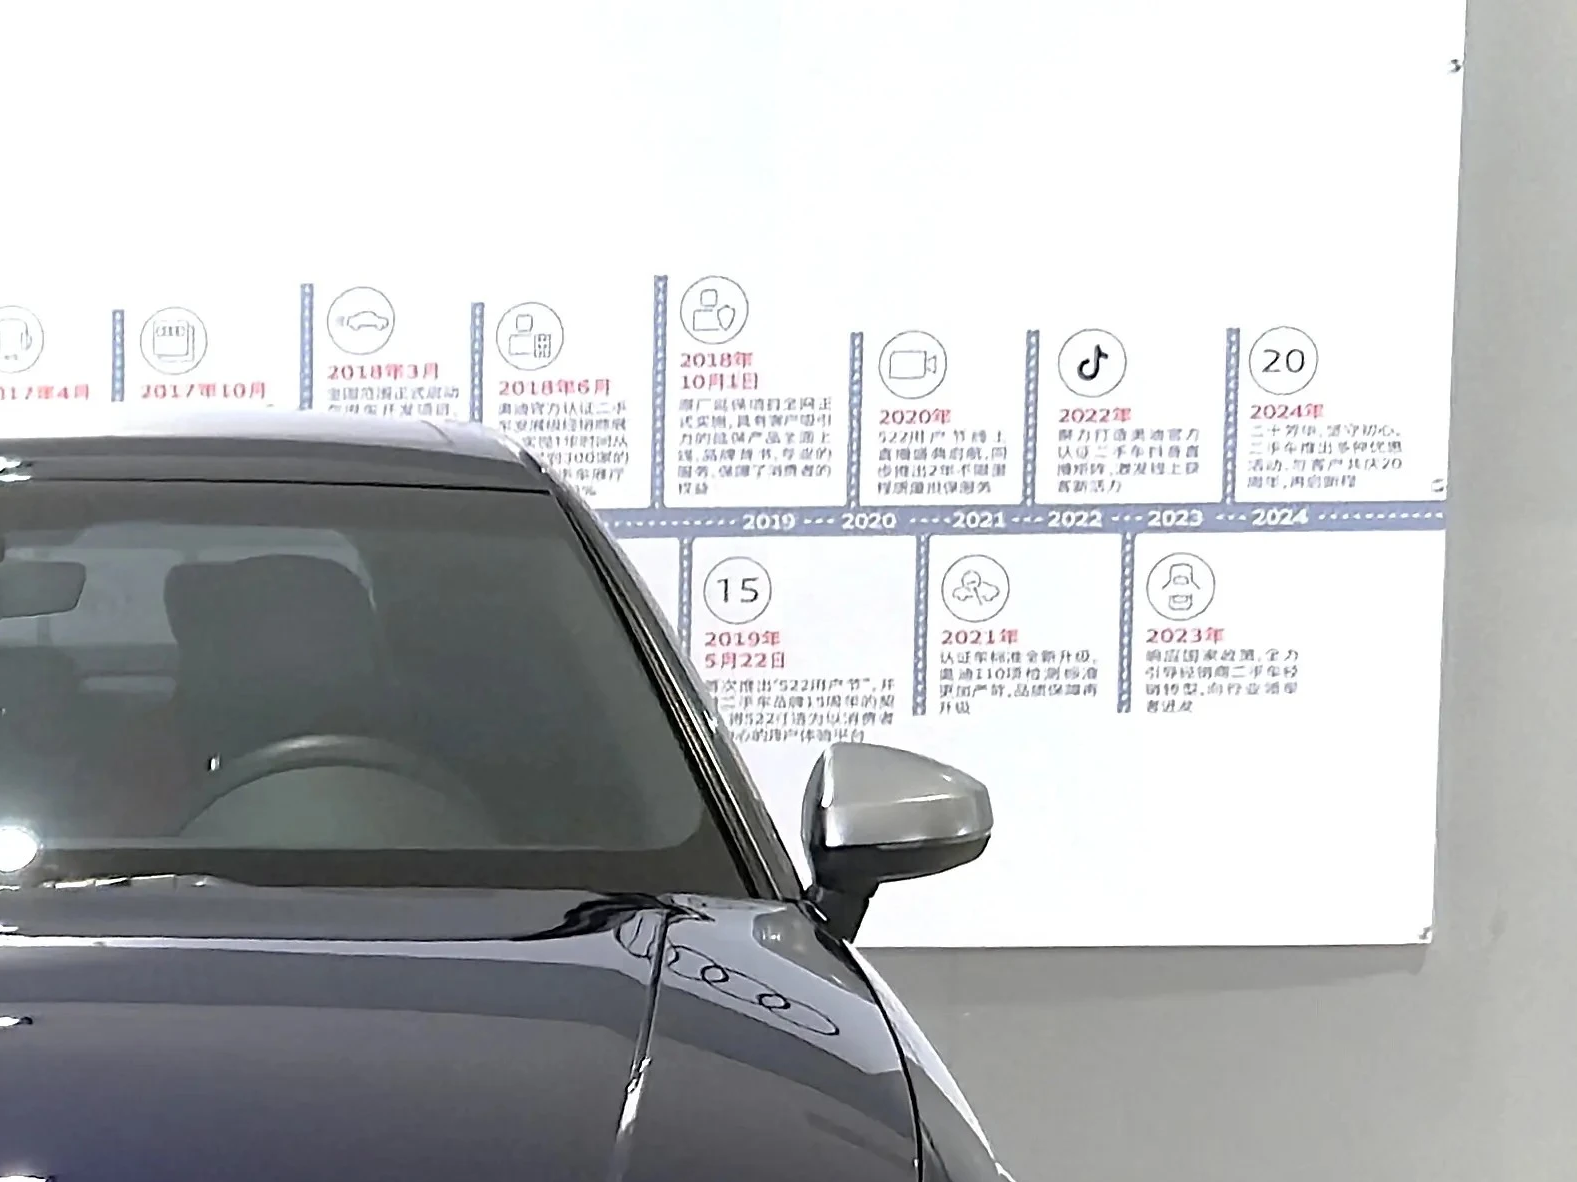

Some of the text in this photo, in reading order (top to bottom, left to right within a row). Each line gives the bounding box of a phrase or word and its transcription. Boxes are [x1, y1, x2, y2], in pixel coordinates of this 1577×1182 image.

[680, 351, 753, 368] 2018年
[1261, 348, 1307, 374] 20
[328, 363, 438, 380] 2018年3月
[499, 379, 610, 396] 2018年6月
[681, 372, 758, 391] 10月1日
[142, 382, 265, 399] 2017年10月
[879, 408, 951, 425] 2020年
[1059, 407, 1131, 423] 2022年
[1250, 403, 1323, 419] 2024年
[744, 514, 795, 529] 2019
[843, 513, 896, 528] 2020
[953, 512, 1004, 527] 2021
[1049, 511, 1101, 527] 2022
[1149, 510, 1202, 526] 2023
[1253, 509, 1308, 525] 2024
[717, 577, 759, 603] 15
[705, 630, 780, 647] 2019年
[941, 629, 1018, 645] 2021年
[1146, 627, 1224, 644] 2023年
[705, 651, 784, 670] 5月22日
